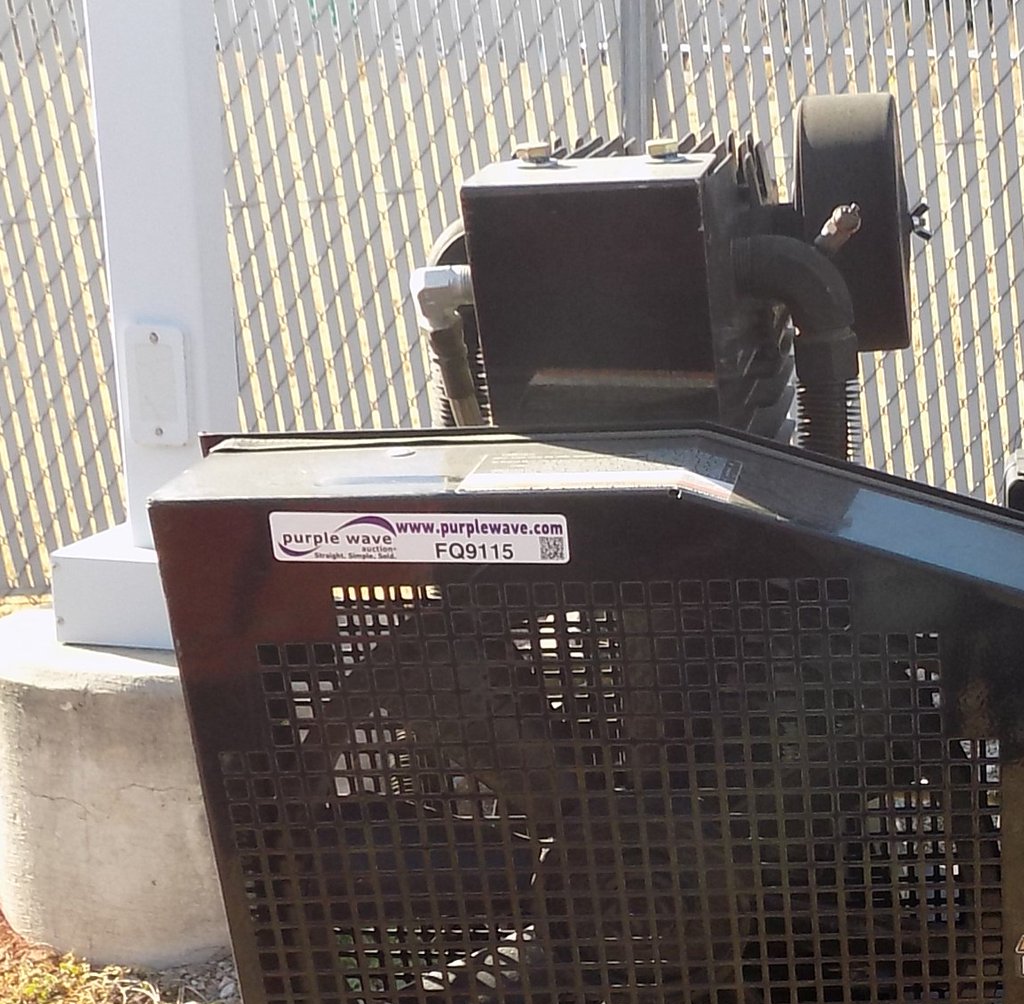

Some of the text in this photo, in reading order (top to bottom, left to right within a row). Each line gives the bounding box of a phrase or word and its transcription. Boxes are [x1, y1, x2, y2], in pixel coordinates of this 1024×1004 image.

[395, 518, 564, 538] www.purplewave.com
[282, 531, 392, 546] purple wave
[314, 552, 346, 560] Straight.
[435, 542, 514, 560] FQ9115
